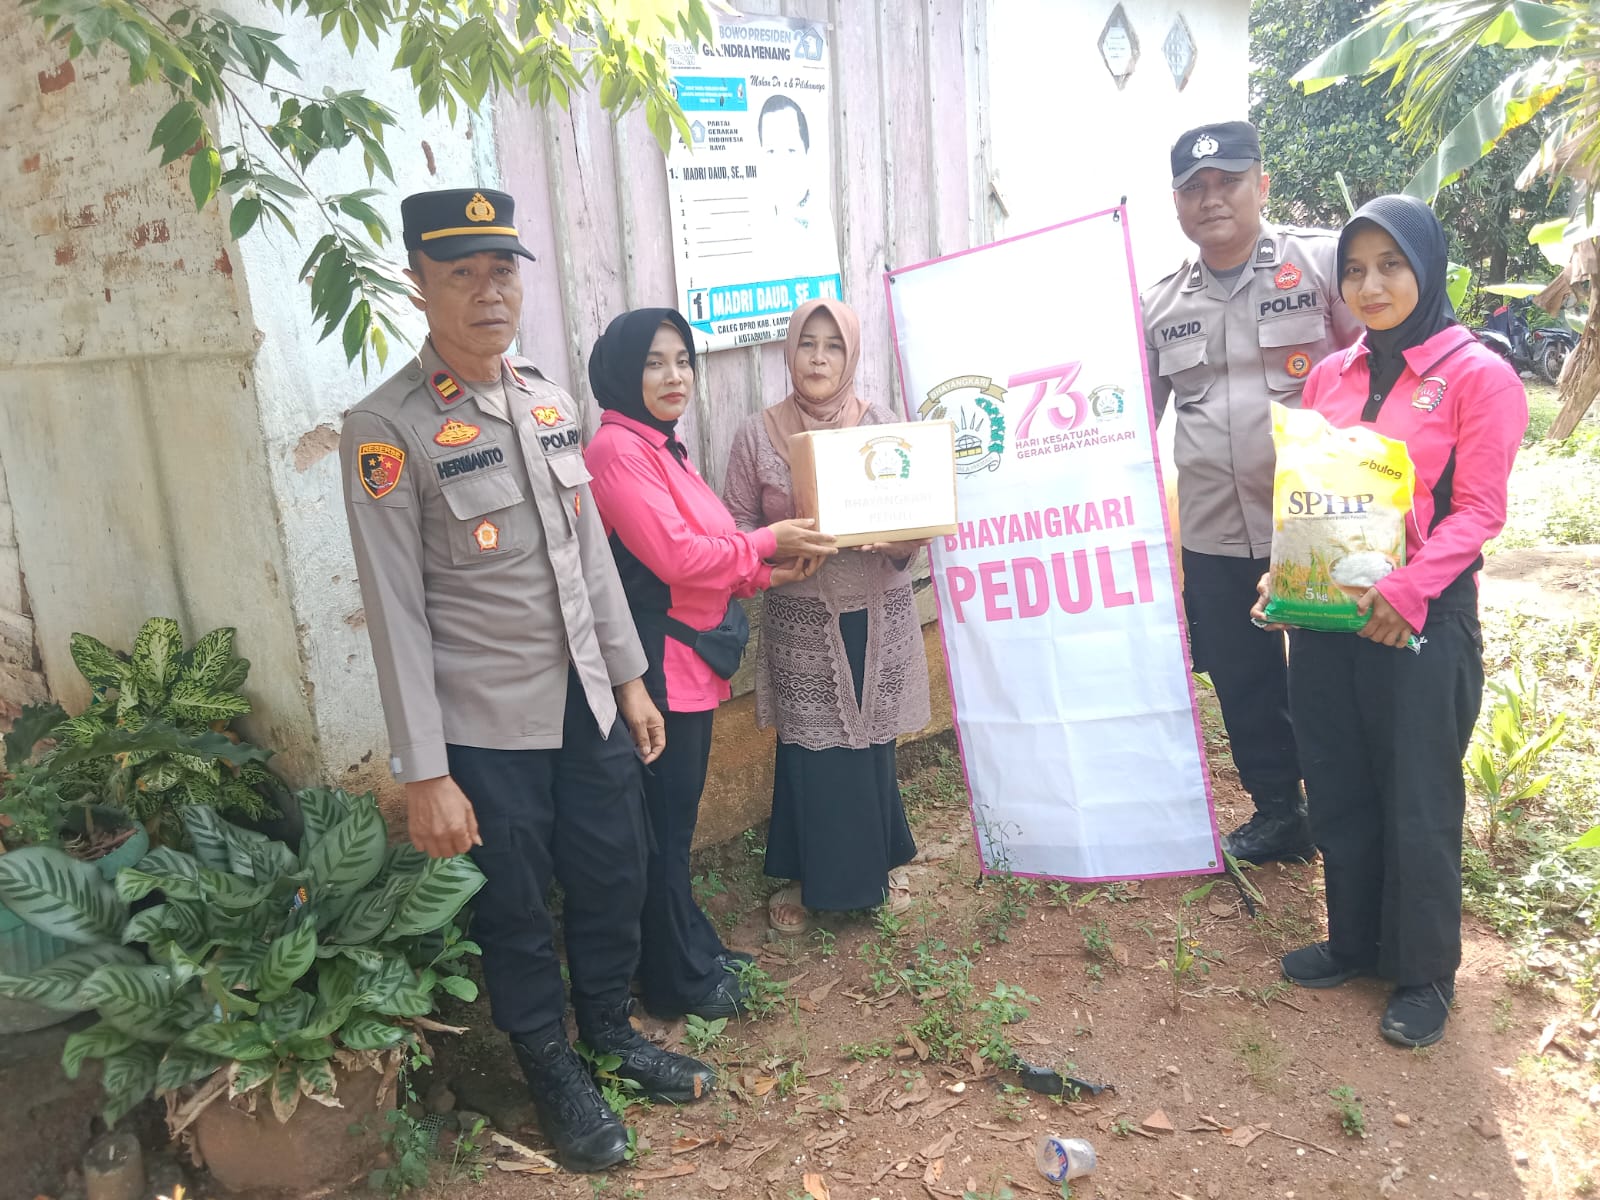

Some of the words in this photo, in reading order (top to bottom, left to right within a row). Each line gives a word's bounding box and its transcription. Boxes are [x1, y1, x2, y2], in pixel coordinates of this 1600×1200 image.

[748, 27, 791, 44] PRESIDEN
[751, 45, 791, 61] MENANG
[669, 168, 679, 180] 1.
[682, 167, 707, 181] MADRI
[708, 166, 730, 182] DAUD,
[712, 288, 753, 317] MADRI
[756, 284, 792, 311] DAUD,
[1260, 293, 1317, 317] POLRI
[717, 323, 738, 334] CALEG
[739, 321, 756, 331] DPRD
[757, 319, 772, 329] KAB.
[772, 316, 790, 327] LAMP
[1160, 321, 1201, 343] YAZID
[1007, 360, 1088, 440] 73
[541, 428, 580, 452] POLRI
[1015, 438, 1040, 450] HARI
[1042, 427, 1099, 445] KESATUAN
[1017, 446, 1052, 460] GERAK
[1054, 430, 1136, 453] BHAYANGKARI
[436, 447, 504, 480] HERMANTO
[1369, 459, 1402, 480] bulog
[944, 495, 1136, 553] BHAYANGKARI
[945, 540, 1155, 624] PEDULI
[1305, 587, 1315, 600] 5
